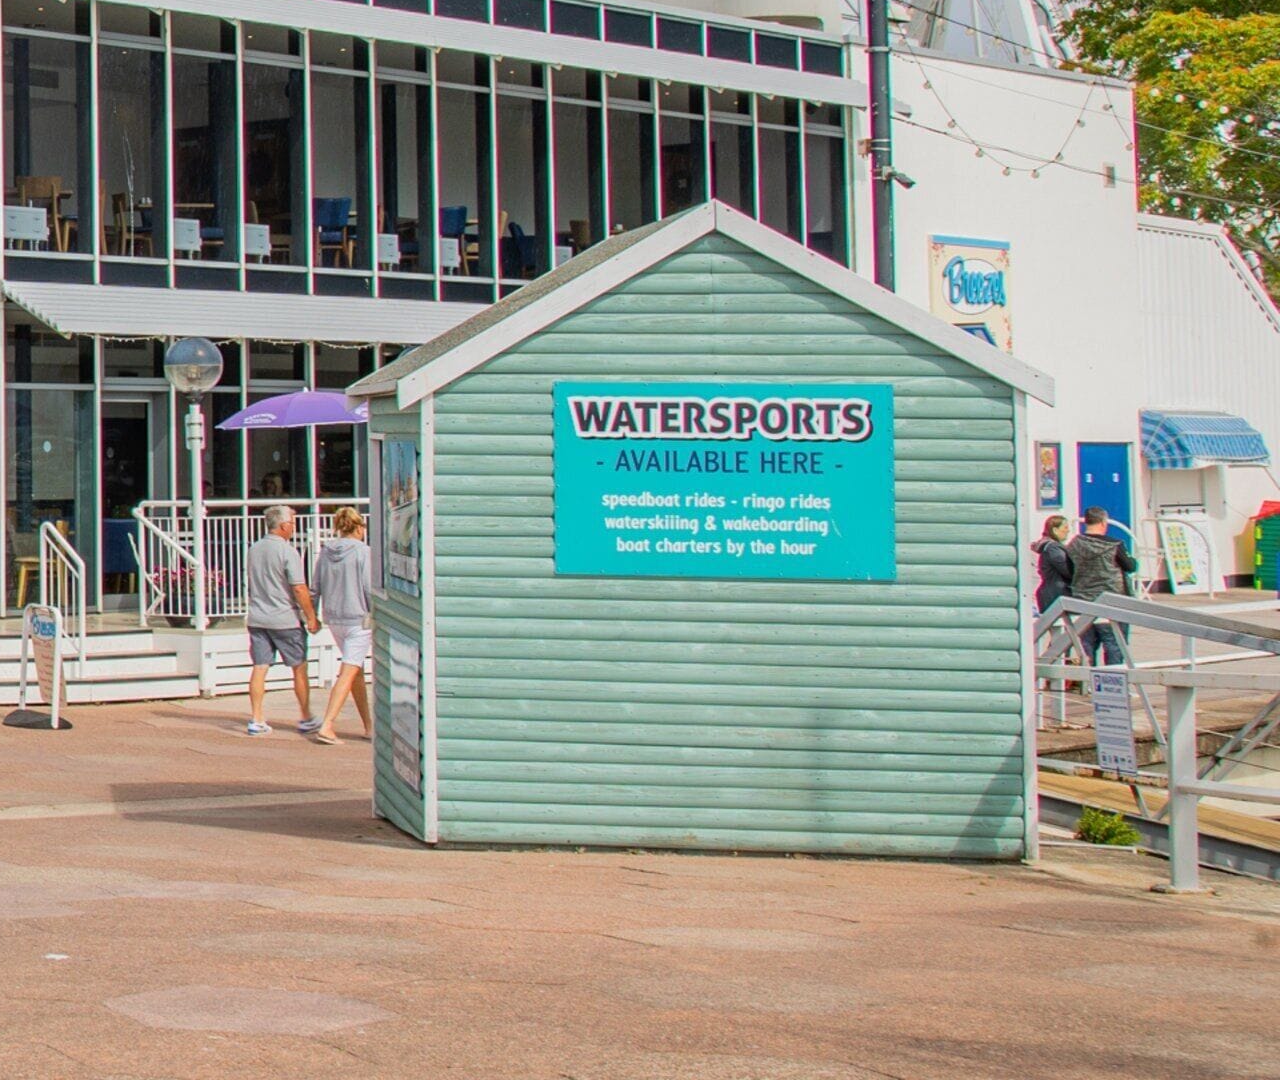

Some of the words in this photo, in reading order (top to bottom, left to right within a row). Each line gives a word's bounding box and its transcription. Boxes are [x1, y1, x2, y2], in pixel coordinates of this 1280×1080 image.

[943, 255, 1007, 307] Breezes
[571, 398, 872, 438] WATERSPORTS
[615, 450, 749, 473] AVAILABLE
[760, 452, 824, 474] HERE
[601, 492, 681, 510] speedboat
[685, 493, 726, 508] rides
[743, 494, 785, 513] ringo
[790, 494, 832, 509] rides
[704, 516, 717, 531] &
[723, 517, 829, 536] wakeboarding
[616, 537, 650, 553] boat
[655, 538, 721, 554] charters
[727, 538, 745, 557] by
[751, 539, 775, 554] the
[780, 540, 817, 555] hour
